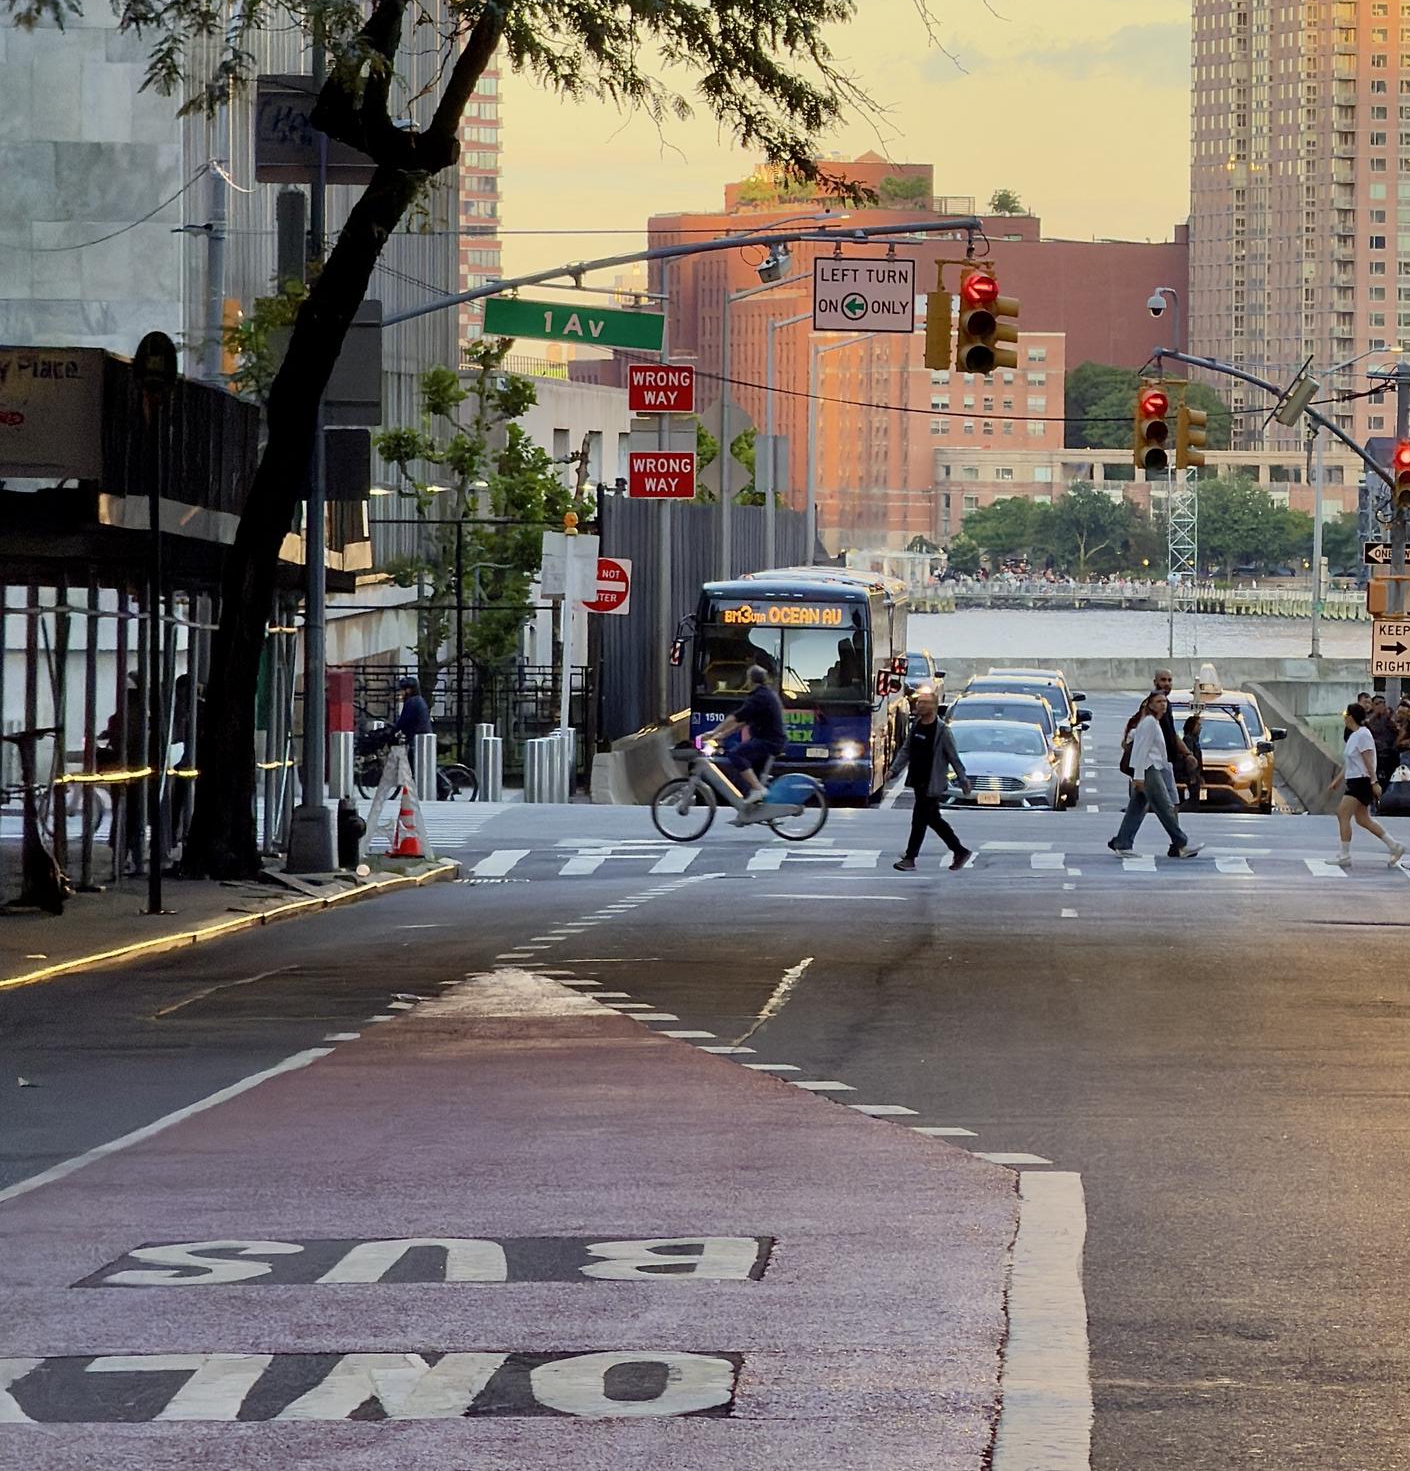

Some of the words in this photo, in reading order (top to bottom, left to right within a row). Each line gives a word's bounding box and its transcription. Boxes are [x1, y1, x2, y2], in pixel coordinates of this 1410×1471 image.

[821, 268, 859, 282] LEFT
[866, 269, 908, 284] TURN
[818, 299, 838, 313] ON
[871, 300, 909, 314] ONLY
[543, 311, 553, 332] 1
[563, 314, 604, 338] Av
[632, 372, 690, 386] WRONG
[644, 391, 678, 405] WAY
[633, 458, 691, 473] WRONG
[644, 478, 679, 492] WAY
[1375, 550, 1392, 558] ONE
[602, 570, 620, 578] NOT
[597, 593, 617, 602] TER
[768, 606, 819, 625] OCEAN
[1379, 625, 1410, 636] KEEP
[103, 1237, 758, 1286] BUS
